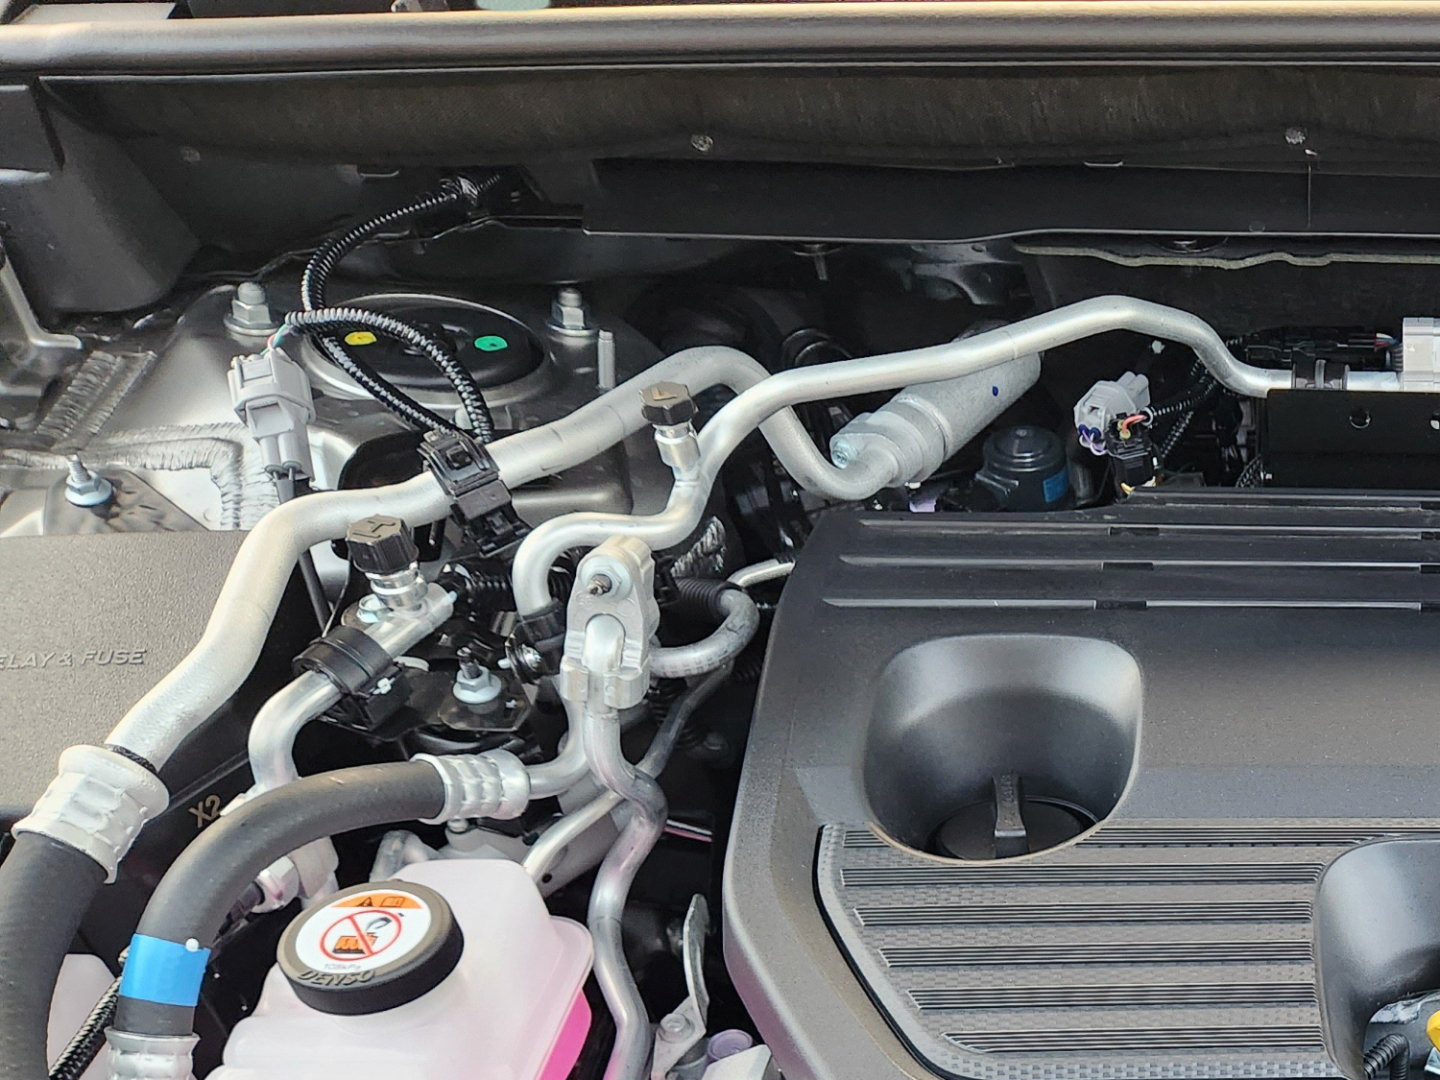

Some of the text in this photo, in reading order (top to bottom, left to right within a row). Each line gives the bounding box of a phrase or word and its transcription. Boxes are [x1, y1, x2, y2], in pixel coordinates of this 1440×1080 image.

[58, 650, 74, 667] &
[80, 649, 148, 666] FUSE
[298, 969, 377, 987] DENSO
